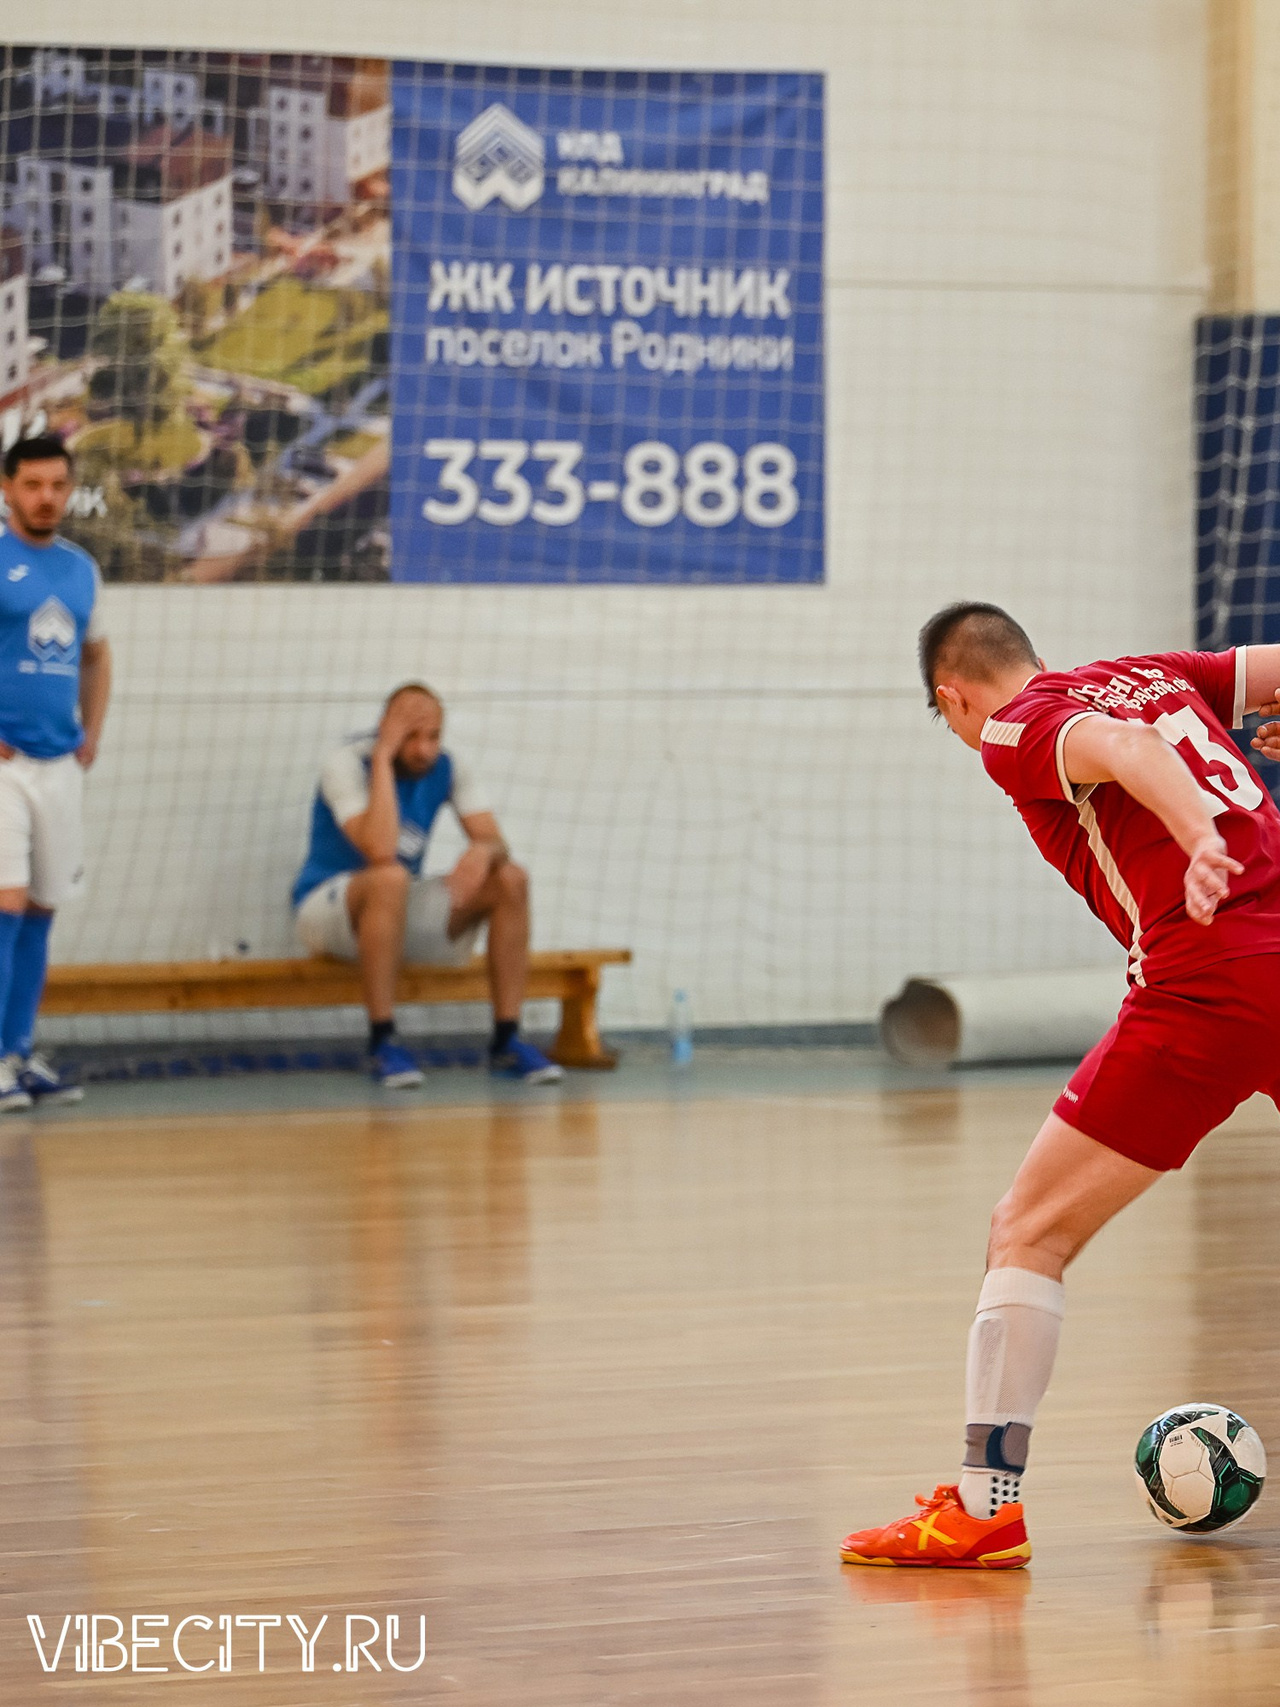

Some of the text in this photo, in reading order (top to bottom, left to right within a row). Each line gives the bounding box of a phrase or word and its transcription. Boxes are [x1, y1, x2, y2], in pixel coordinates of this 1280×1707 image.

[428, 260, 791, 319] ЖК ИСТОЧНИК
[425, 320, 794, 376] поселок Родники
[422, 438, 799, 528] 333-888
